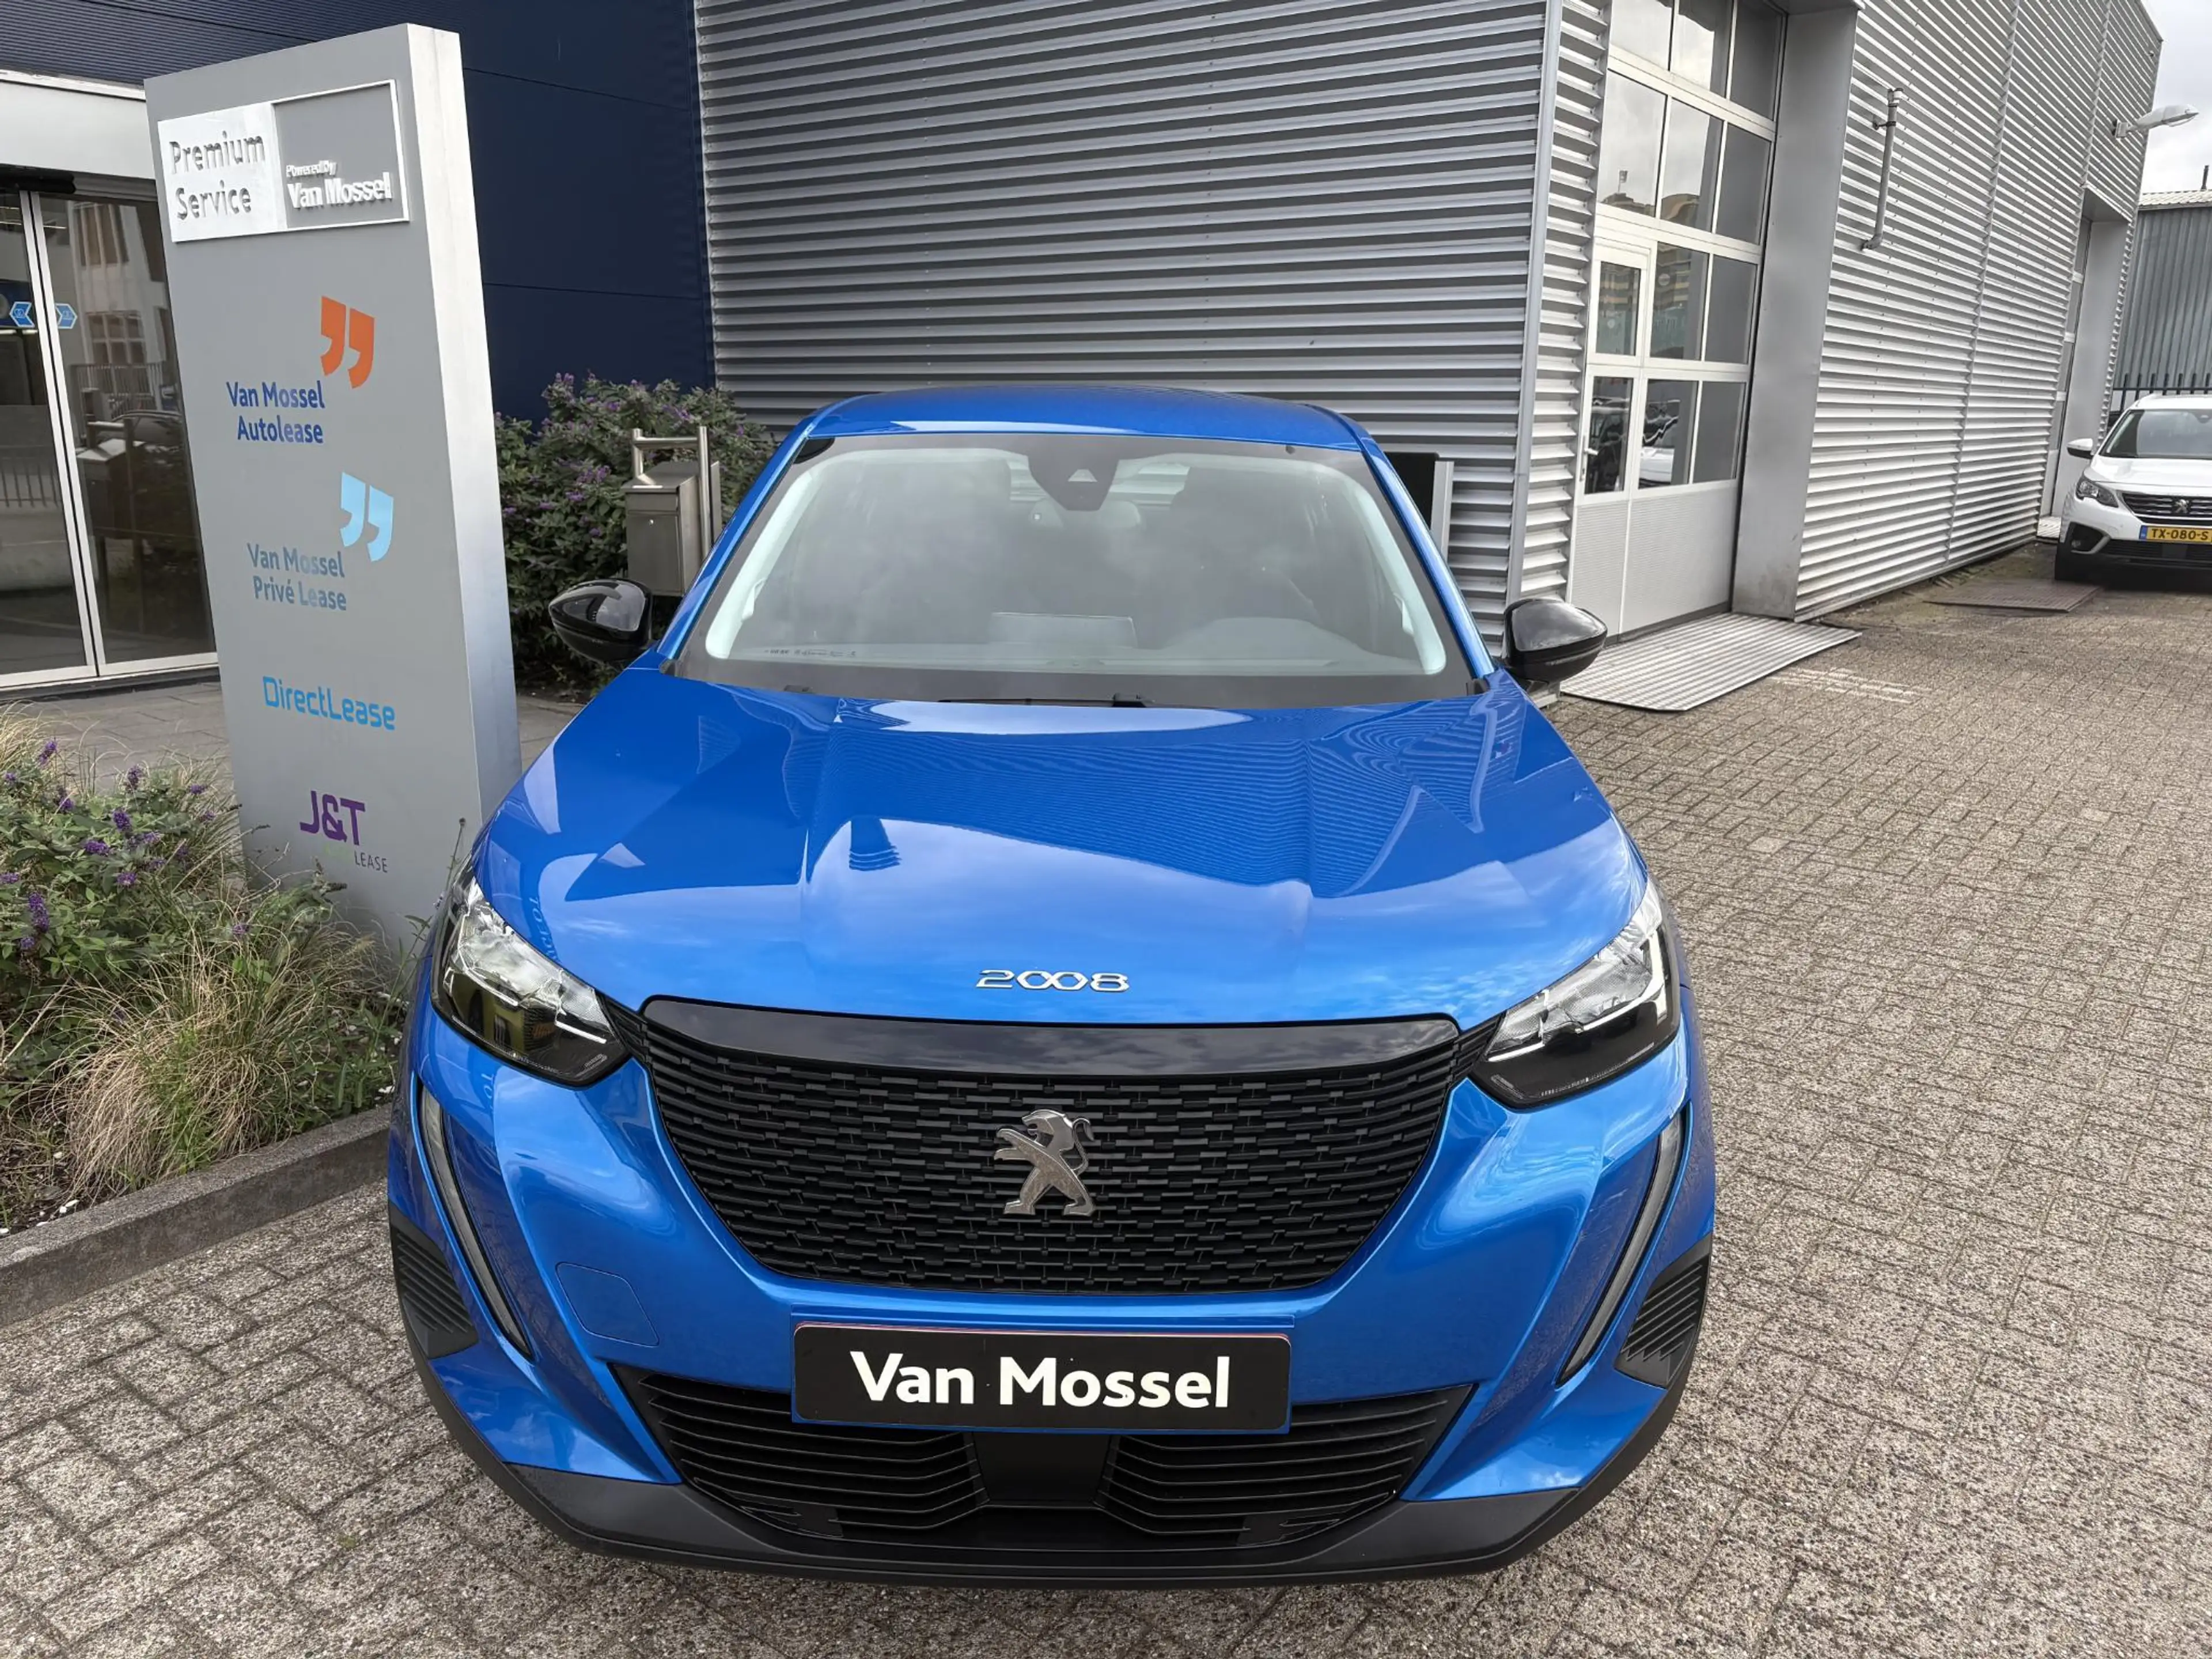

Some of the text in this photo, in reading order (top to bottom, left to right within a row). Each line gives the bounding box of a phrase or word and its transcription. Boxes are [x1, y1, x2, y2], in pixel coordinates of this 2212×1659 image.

[169, 130, 266, 173] Premium
[286, 160, 324, 178] Powered
[176, 180, 252, 220] Service
[287, 172, 392, 209] Van Mossel
[226, 380, 325, 409] Van Mossel
[237, 415, 324, 444] Autolease
[2152, 528, 2209, 540] TX-080-S
[247, 543, 345, 578] Van Mossel
[252, 575, 347, 611] Privé Lease
[263, 676, 395, 731] DirectLease
[300, 790, 366, 846] J&T
[354, 850, 388, 873] LEASE
[976, 969, 1130, 992] 2008
[850, 1351, 1230, 1408] Van Mossel
